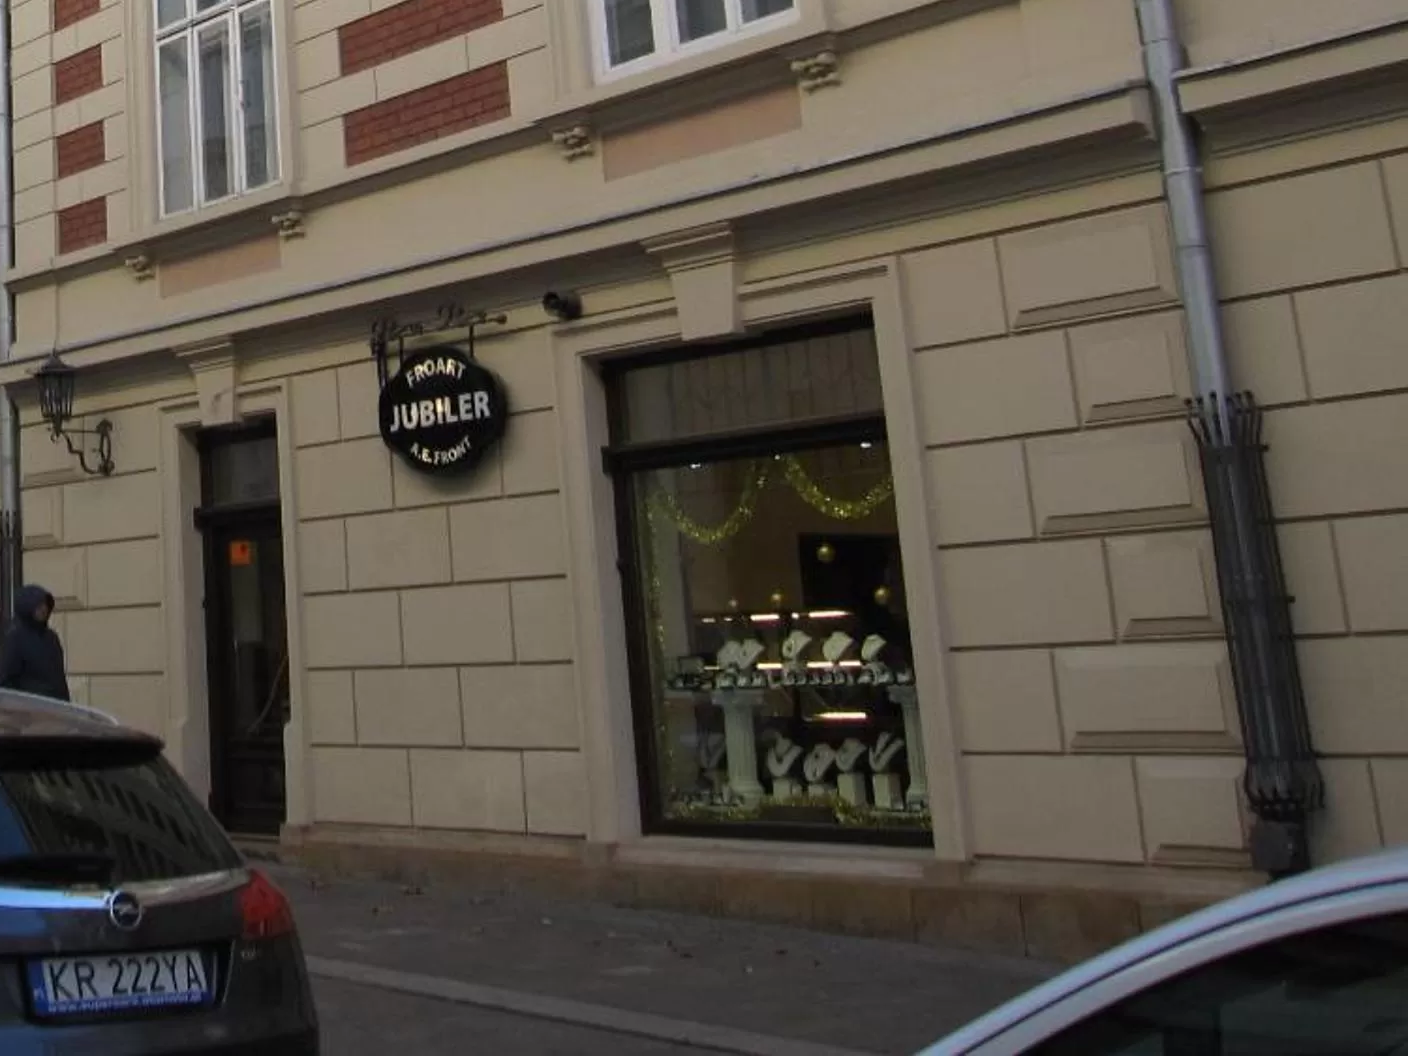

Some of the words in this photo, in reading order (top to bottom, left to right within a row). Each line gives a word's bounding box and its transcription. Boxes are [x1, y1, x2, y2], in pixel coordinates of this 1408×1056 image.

[406, 358, 466, 388] FROART
[390, 391, 491, 433] JUBILER
[48, 959, 97, 1000] KR
[108, 955, 204, 995] 222YA
